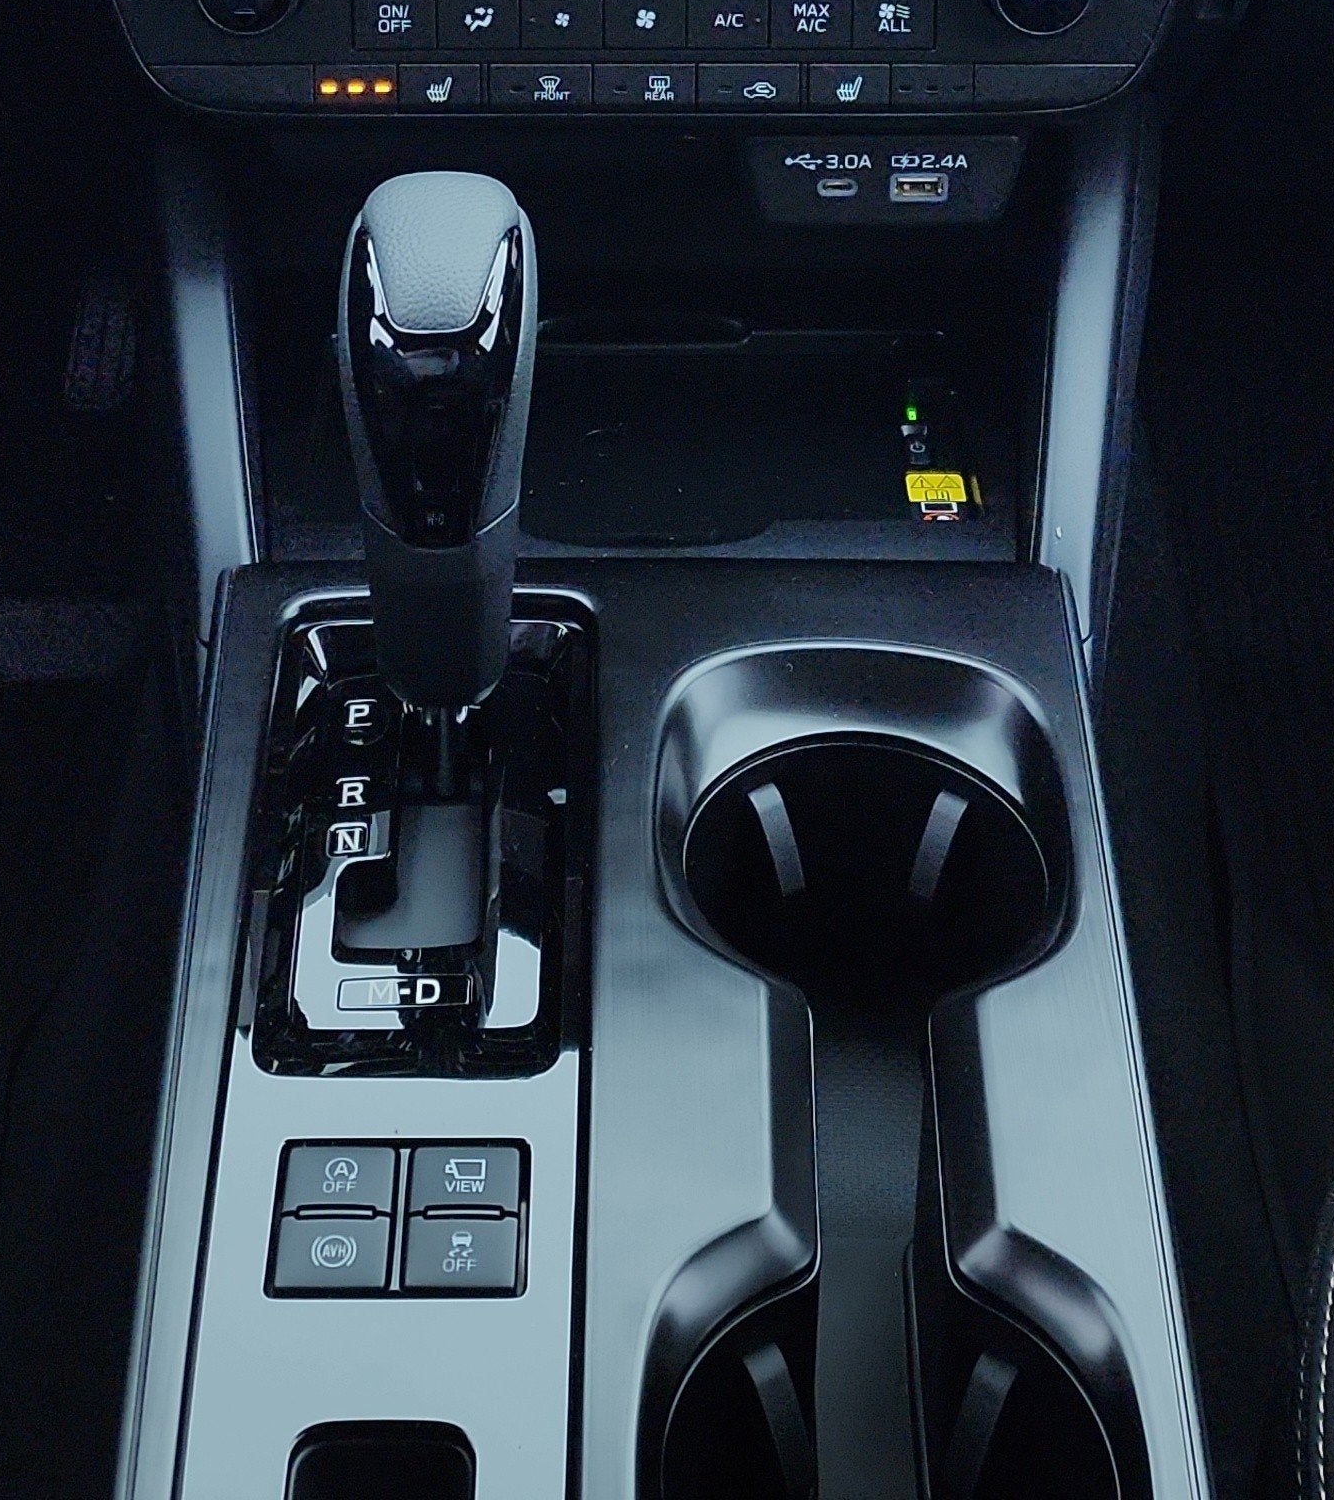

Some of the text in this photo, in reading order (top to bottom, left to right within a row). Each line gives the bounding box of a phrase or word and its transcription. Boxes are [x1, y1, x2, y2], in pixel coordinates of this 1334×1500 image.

[378, 4, 410, 19] ON/
[793, 3, 831, 18] MAX
[377, 19, 413, 33] OFF
[714, 13, 745, 28] A/C
[796, 19, 828, 33] A/C
[878, 19, 912, 33] ALL
[533, 91, 571, 101] FRONT
[644, 91, 675, 101] REAR
[825, 154, 872, 169] 3.0A
[921, 154, 968, 169] 2.4A
[347, 703, 371, 727] P
[339, 781, 366, 806] R
[334, 827, 365, 854] N
[322, 1180, 358, 1194] OFF
[444, 1180, 486, 1193] VIEW
[322, 1243, 348, 1259] AVH
[442, 1258, 478, 1273] OFF
